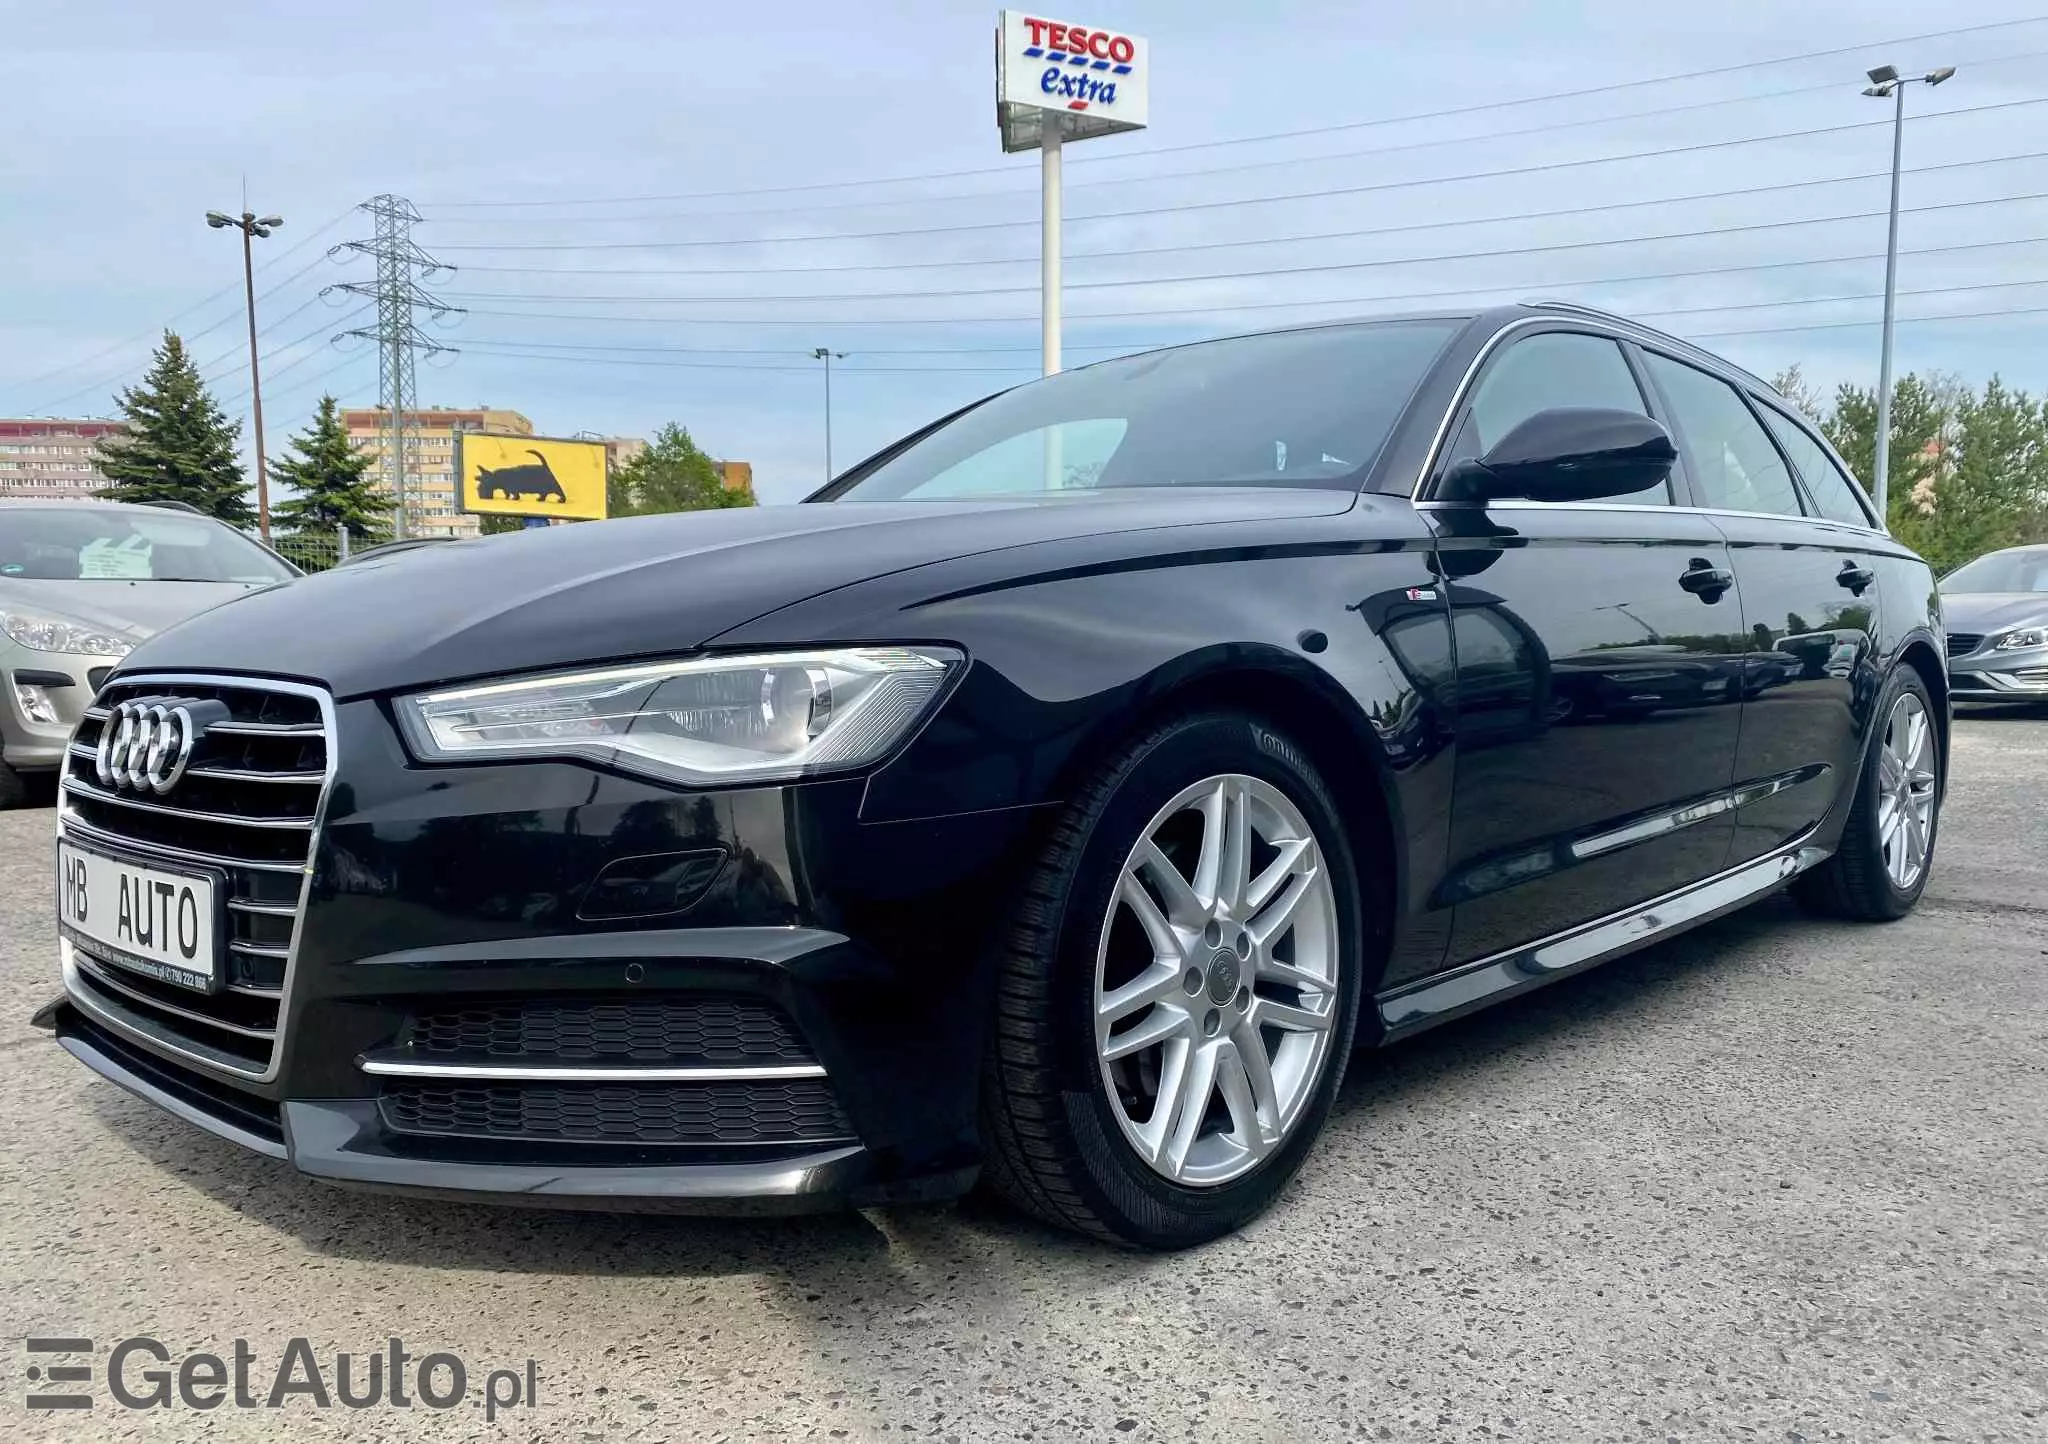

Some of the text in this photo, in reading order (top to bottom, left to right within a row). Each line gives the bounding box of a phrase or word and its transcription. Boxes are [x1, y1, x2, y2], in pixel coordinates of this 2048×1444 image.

[1024, 17, 1134, 63] TESCO
[1040, 66, 1117, 105] extra
[65, 854, 88, 922] MB
[117, 872, 198, 960] AUTO
